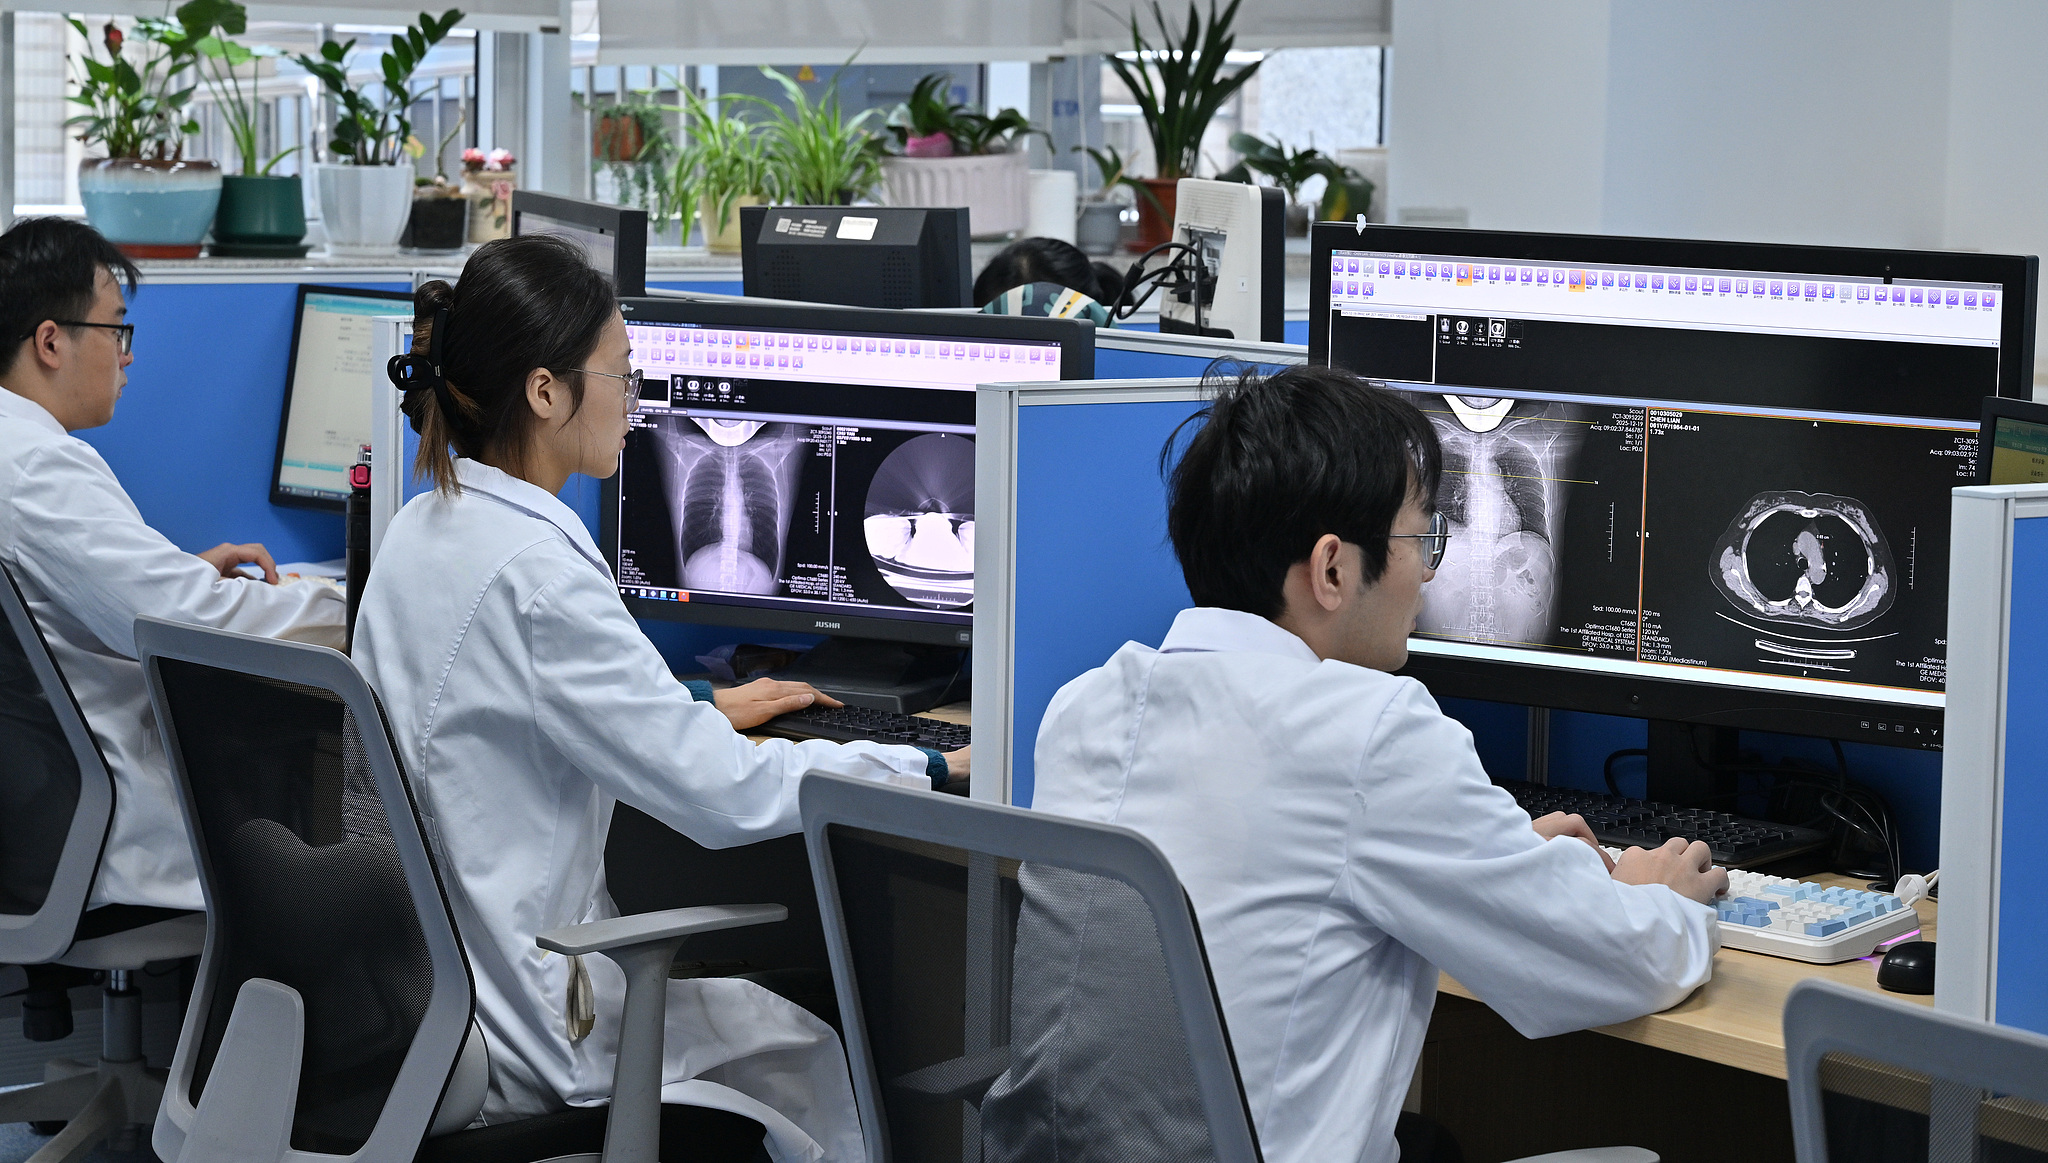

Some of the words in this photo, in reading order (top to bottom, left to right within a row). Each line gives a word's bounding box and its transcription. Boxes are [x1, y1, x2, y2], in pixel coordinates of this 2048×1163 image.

[1605, 606, 1621, 614] 100.00
[1585, 623, 1604, 631] Optima
[1578, 628, 1600, 636] Affiliated
[1590, 636, 1614, 644] MEDICAL
[1615, 638, 1635, 646] SYSTEMS
[1642, 635, 1669, 643] STANDARD
[1669, 656, 1707, 666] (Mediastinum)
[1923, 656, 1944, 664] Optima
[1915, 662, 1940, 671] Affiliated
